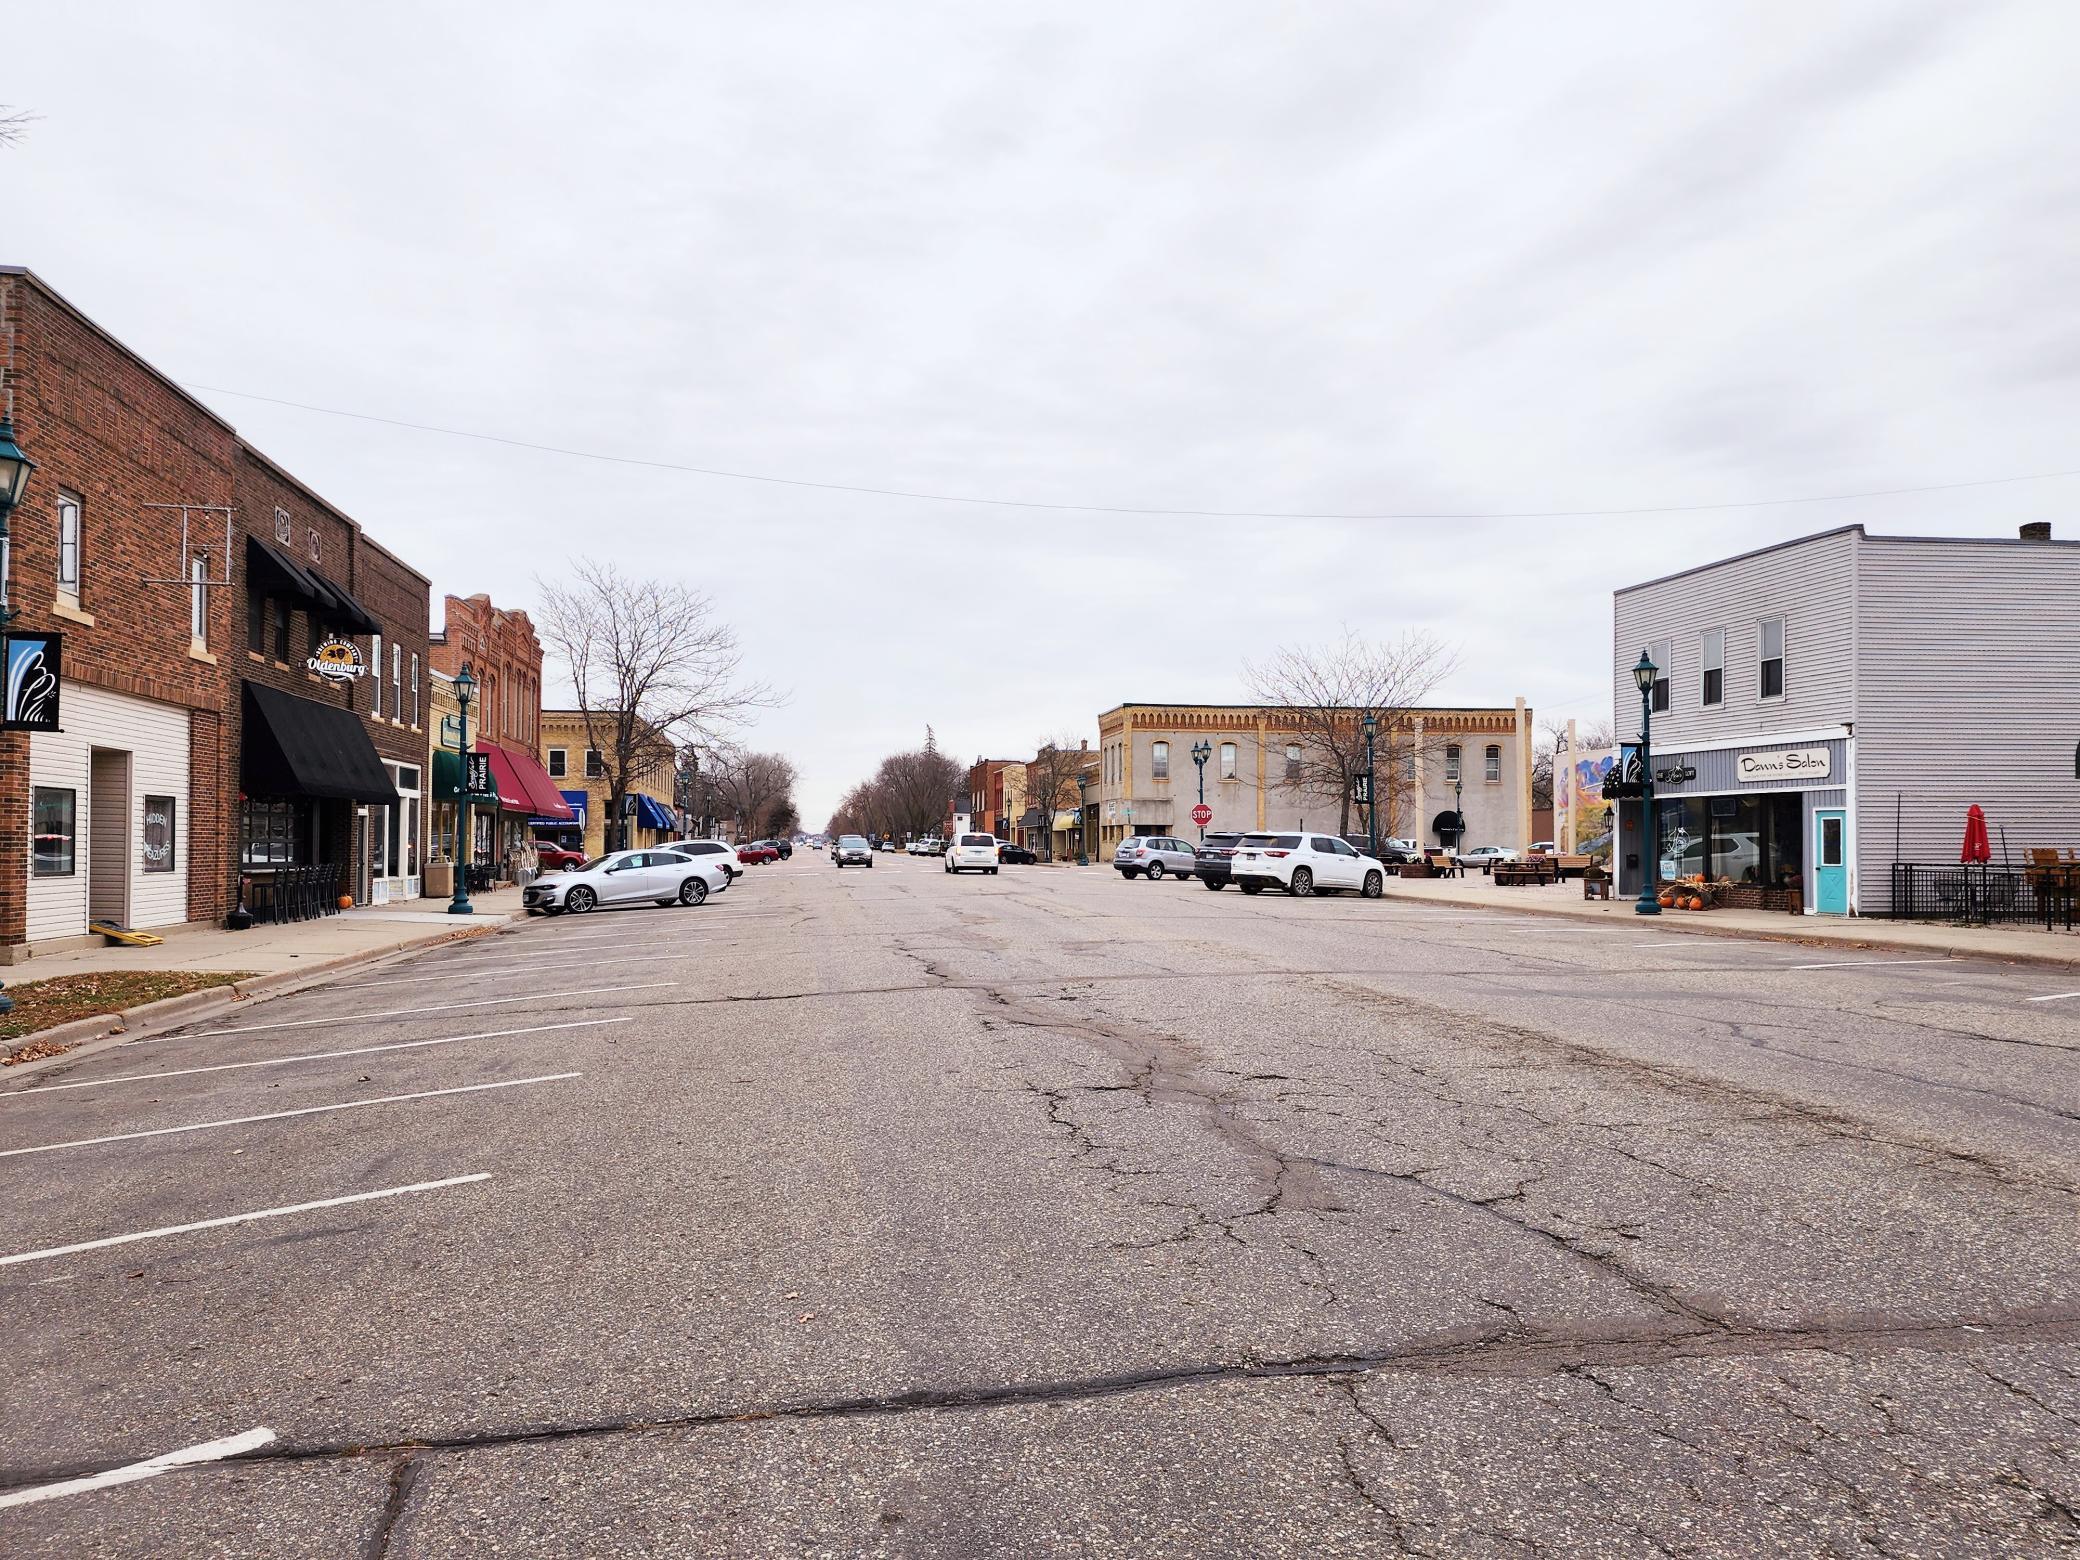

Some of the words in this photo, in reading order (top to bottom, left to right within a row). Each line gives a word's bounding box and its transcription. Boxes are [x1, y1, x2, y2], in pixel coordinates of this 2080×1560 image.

[307, 658, 366, 676] Oldenburg
[1786, 753, 1826, 769] Salon
[479, 756, 487, 790] PRAIRIE
[146, 812, 168, 828] HIDDEN
[1192, 810, 1211, 819] STOP
